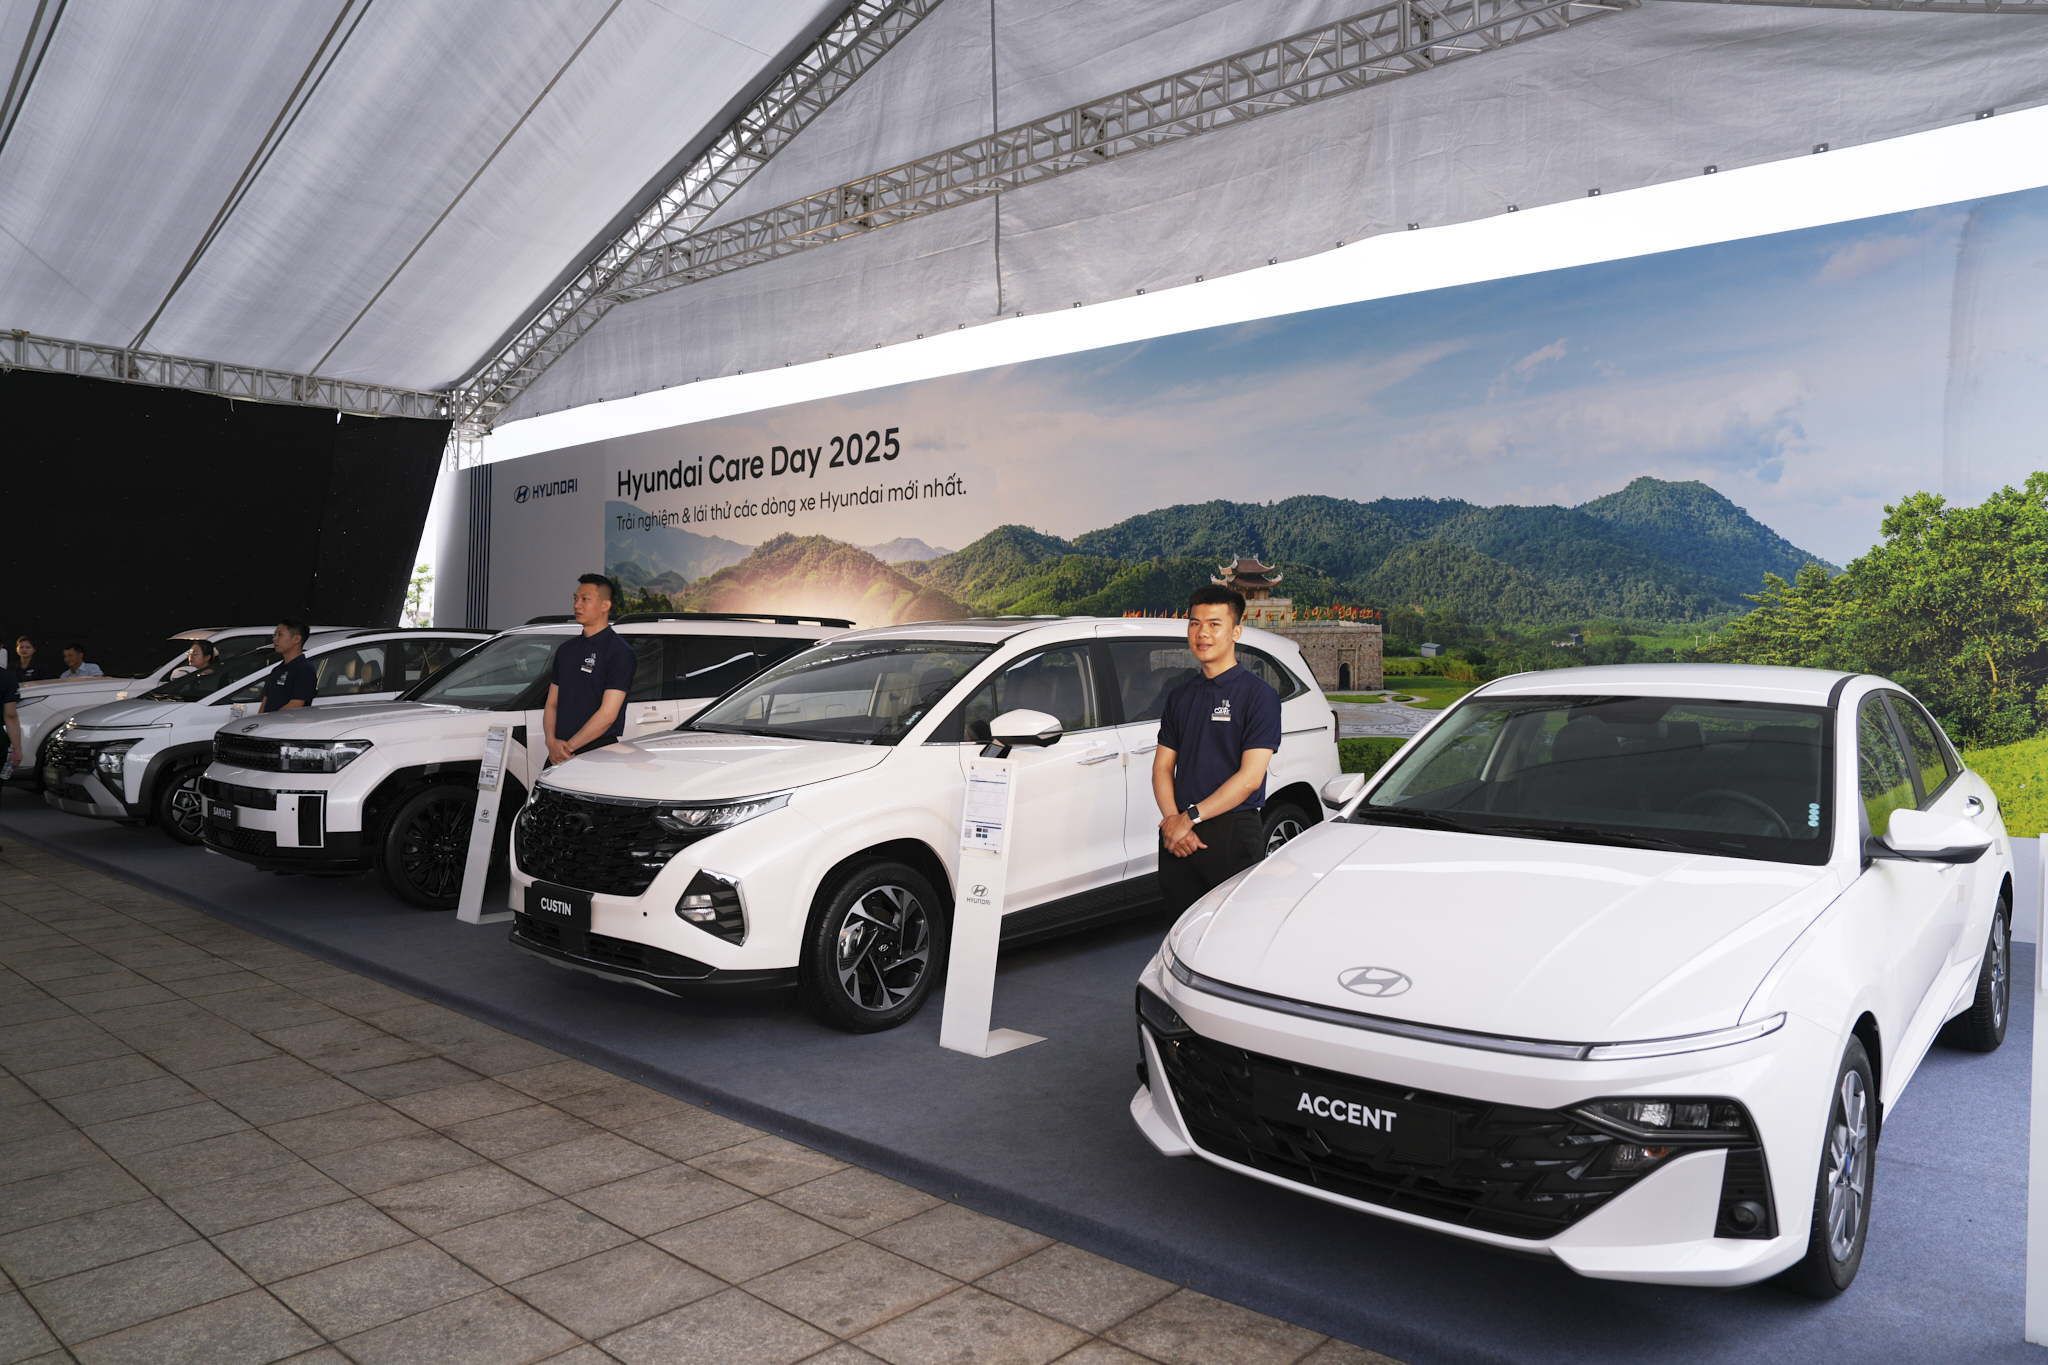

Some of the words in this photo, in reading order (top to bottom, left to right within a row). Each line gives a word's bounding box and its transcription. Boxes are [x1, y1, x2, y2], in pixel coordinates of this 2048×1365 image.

[617, 455, 703, 501] Hyundai
[708, 454, 764, 484] Care
[771, 445, 822, 479] Day
[829, 427, 900, 468] 2025
[532, 478, 578, 499] HYUNDAI
[617, 513, 635, 531] Trải
[638, 510, 679, 532] nghiệm
[682, 507, 691, 524] &
[694, 504, 708, 522] lái
[710, 501, 732, 521] thử
[733, 500, 758, 518] các
[761, 496, 796, 517] dòng
[800, 496, 816, 511] xe
[820, 484, 883, 513] Hyundai
[888, 480, 918, 502] mới
[923, 472, 967, 498] nhất.
[540, 897, 572, 916] CUSTIN
[966, 897, 991, 906] HYUNDAI
[1297, 1092, 1397, 1133] ACCENT
